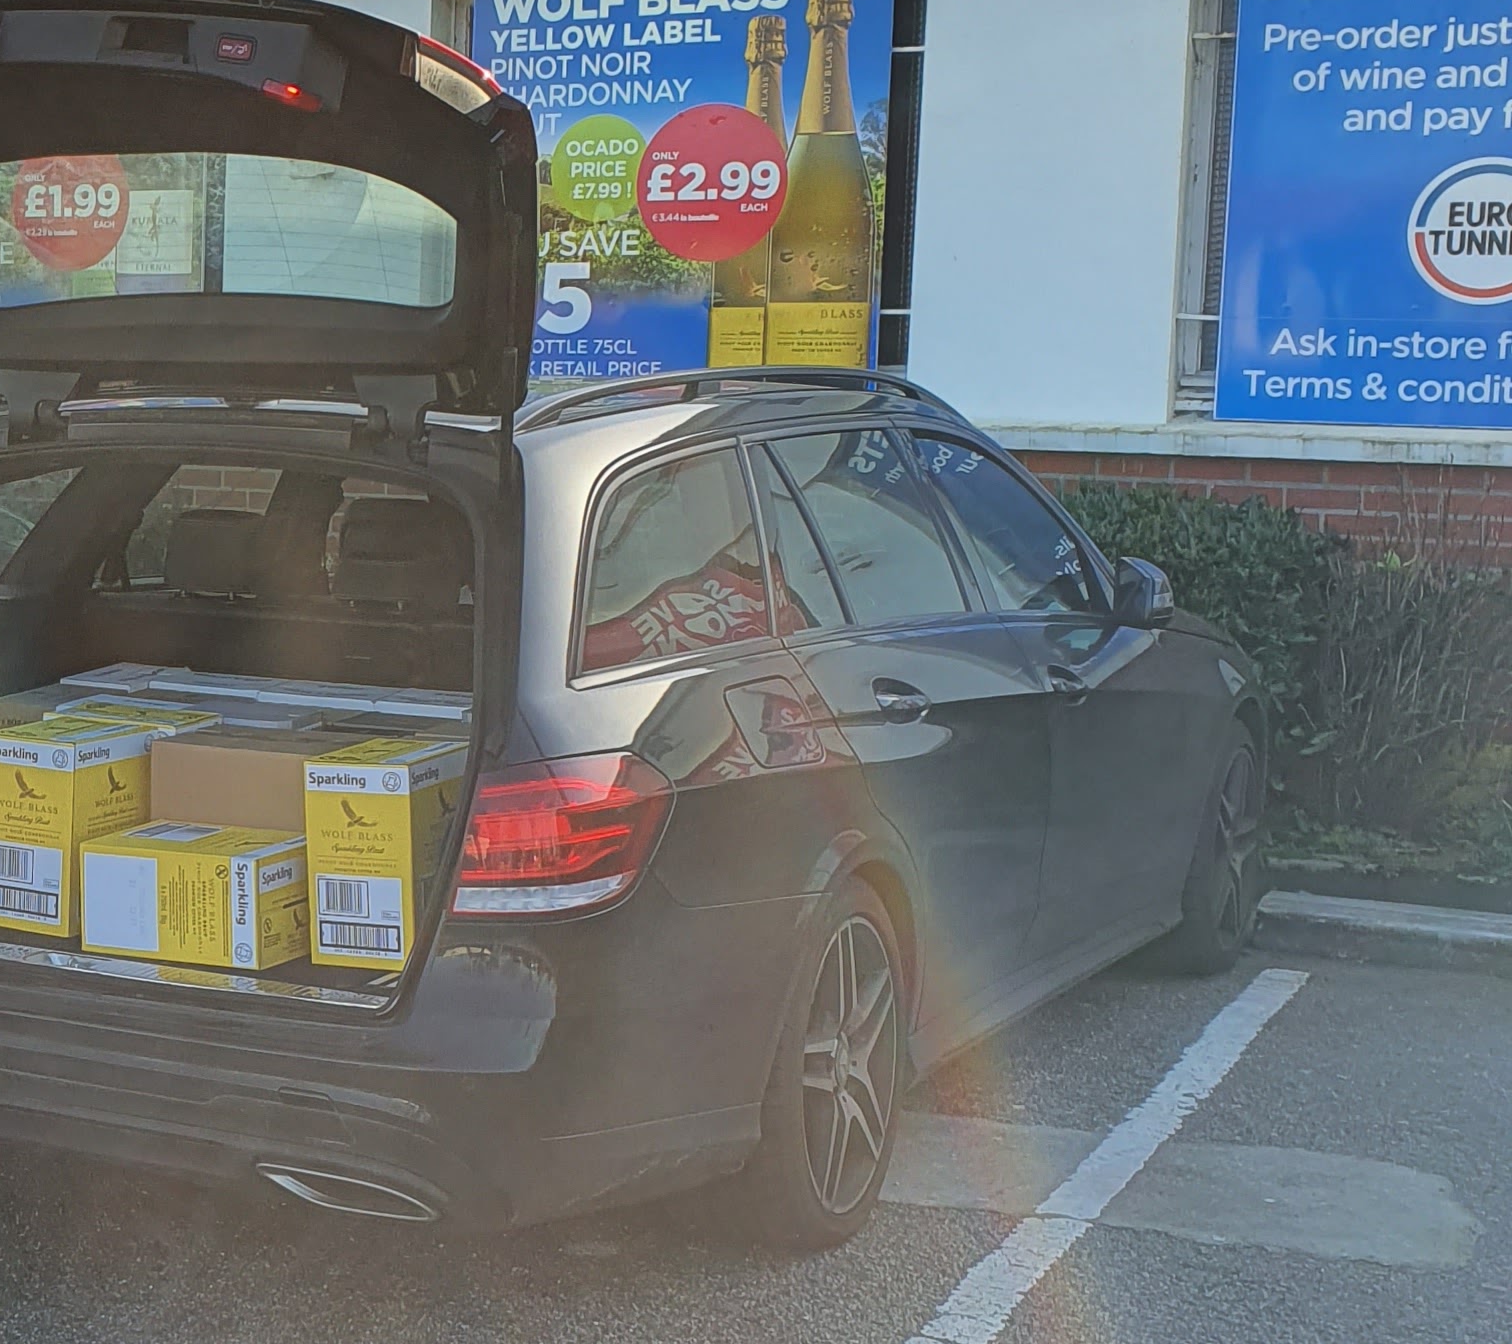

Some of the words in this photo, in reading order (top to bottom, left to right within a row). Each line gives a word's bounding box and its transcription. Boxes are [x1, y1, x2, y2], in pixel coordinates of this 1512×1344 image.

[490, 23, 615, 53] YELLOW
[623, 18, 721, 47] LABEL
[1264, 19, 1437, 53] Pre-order
[1444, 16, 1512, 55] just
[491, 54, 574, 82] PINOT
[581, 51, 652, 78] NOIR
[1292, 62, 1331, 93] of
[1340, 61, 1426, 91] wine
[1436, 57, 1508, 89] and
[1343, 101, 1412, 133] and
[1423, 105, 1493, 138] pay
[565, 139, 638, 157] OCADO
[652, 151, 679, 161] ONLY
[570, 160, 627, 178] PRICE
[572, 182, 621, 200] £7.99
[646, 160, 781, 202] £2.99
[24, 183, 120, 218] £1.99
[740, 203, 768, 213] EACH
[93, 220, 115, 229] EACH
[560, 230, 640, 257] SAVE
[1429, 229, 1512, 256] TUNN
[531, 340, 588, 354] OTTLE
[593, 339, 637, 354] 75CL
[1270, 327, 1337, 357] Ask
[1347, 328, 1487, 360] in-store
[541, 361, 602, 376] RETAIL
[1243, 369, 1352, 401] Terms
[1361, 373, 1388, 401] &
[1398, 372, 1512, 405] condit
[77, 746, 110, 764] Sparkling
[308, 771, 366, 788] Sparkling
[28, 802, 58, 815] BLASS
[321, 829, 353, 840] WOLF
[357, 831, 394, 842] BLASS
[262, 865, 293, 885] Sparkling
[236, 862, 249, 926] Sparkling
